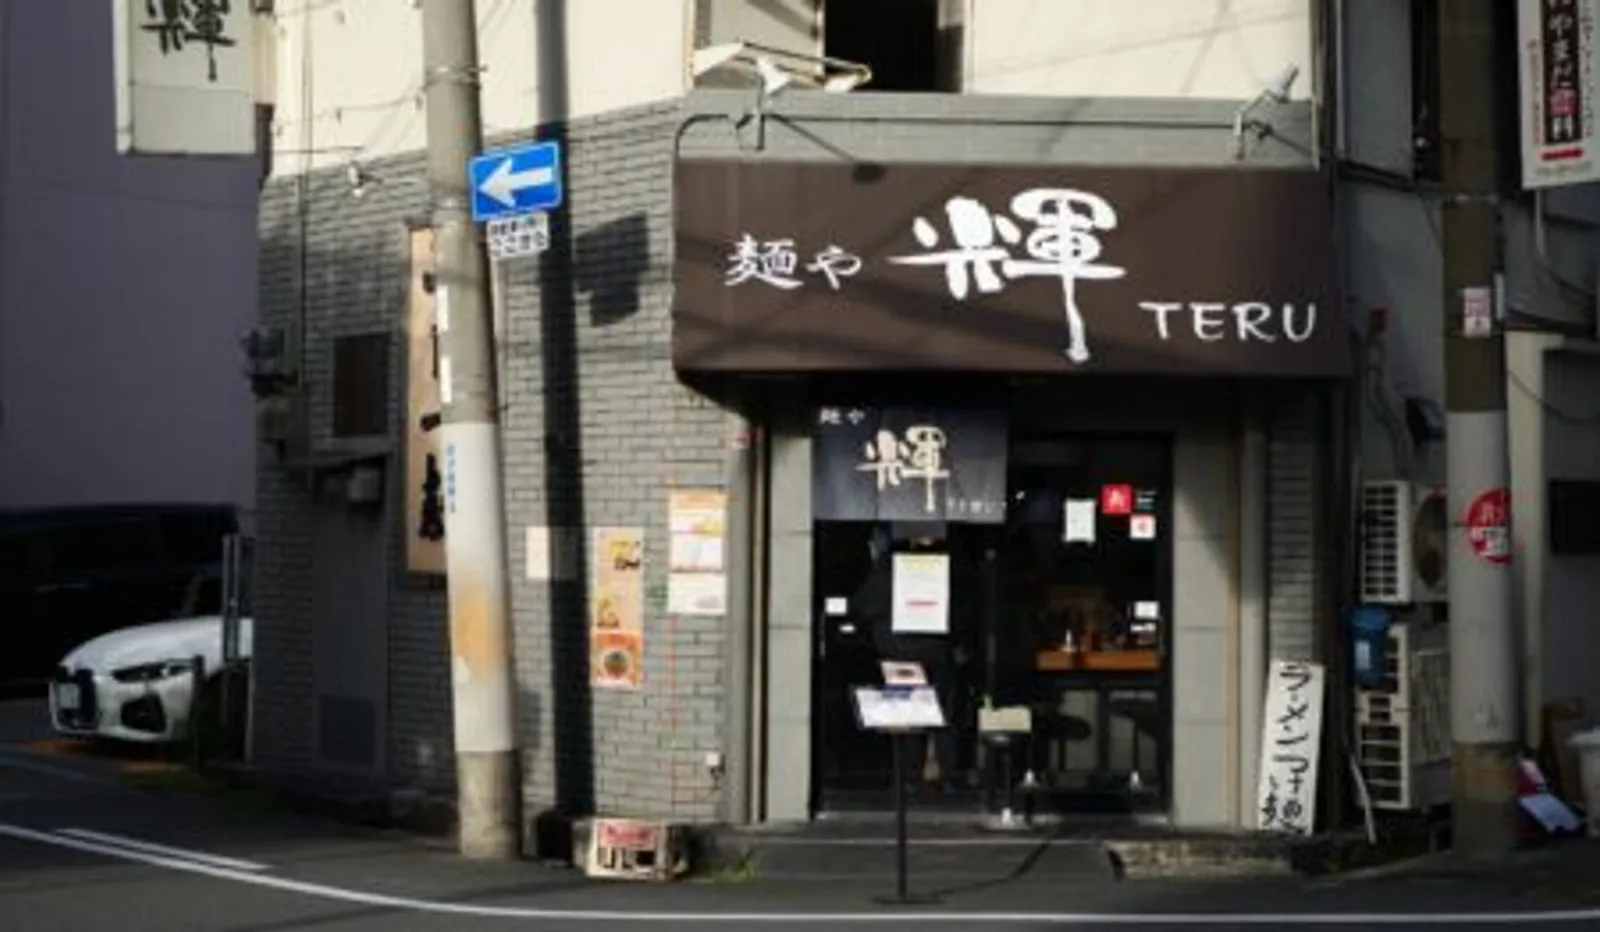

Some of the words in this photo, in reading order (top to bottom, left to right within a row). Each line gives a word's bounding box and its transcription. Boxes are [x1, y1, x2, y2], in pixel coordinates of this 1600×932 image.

[723, 234, 863, 291] 麺や
[889, 188, 1126, 364] 輝
[1138, 301, 1318, 342] TERU
